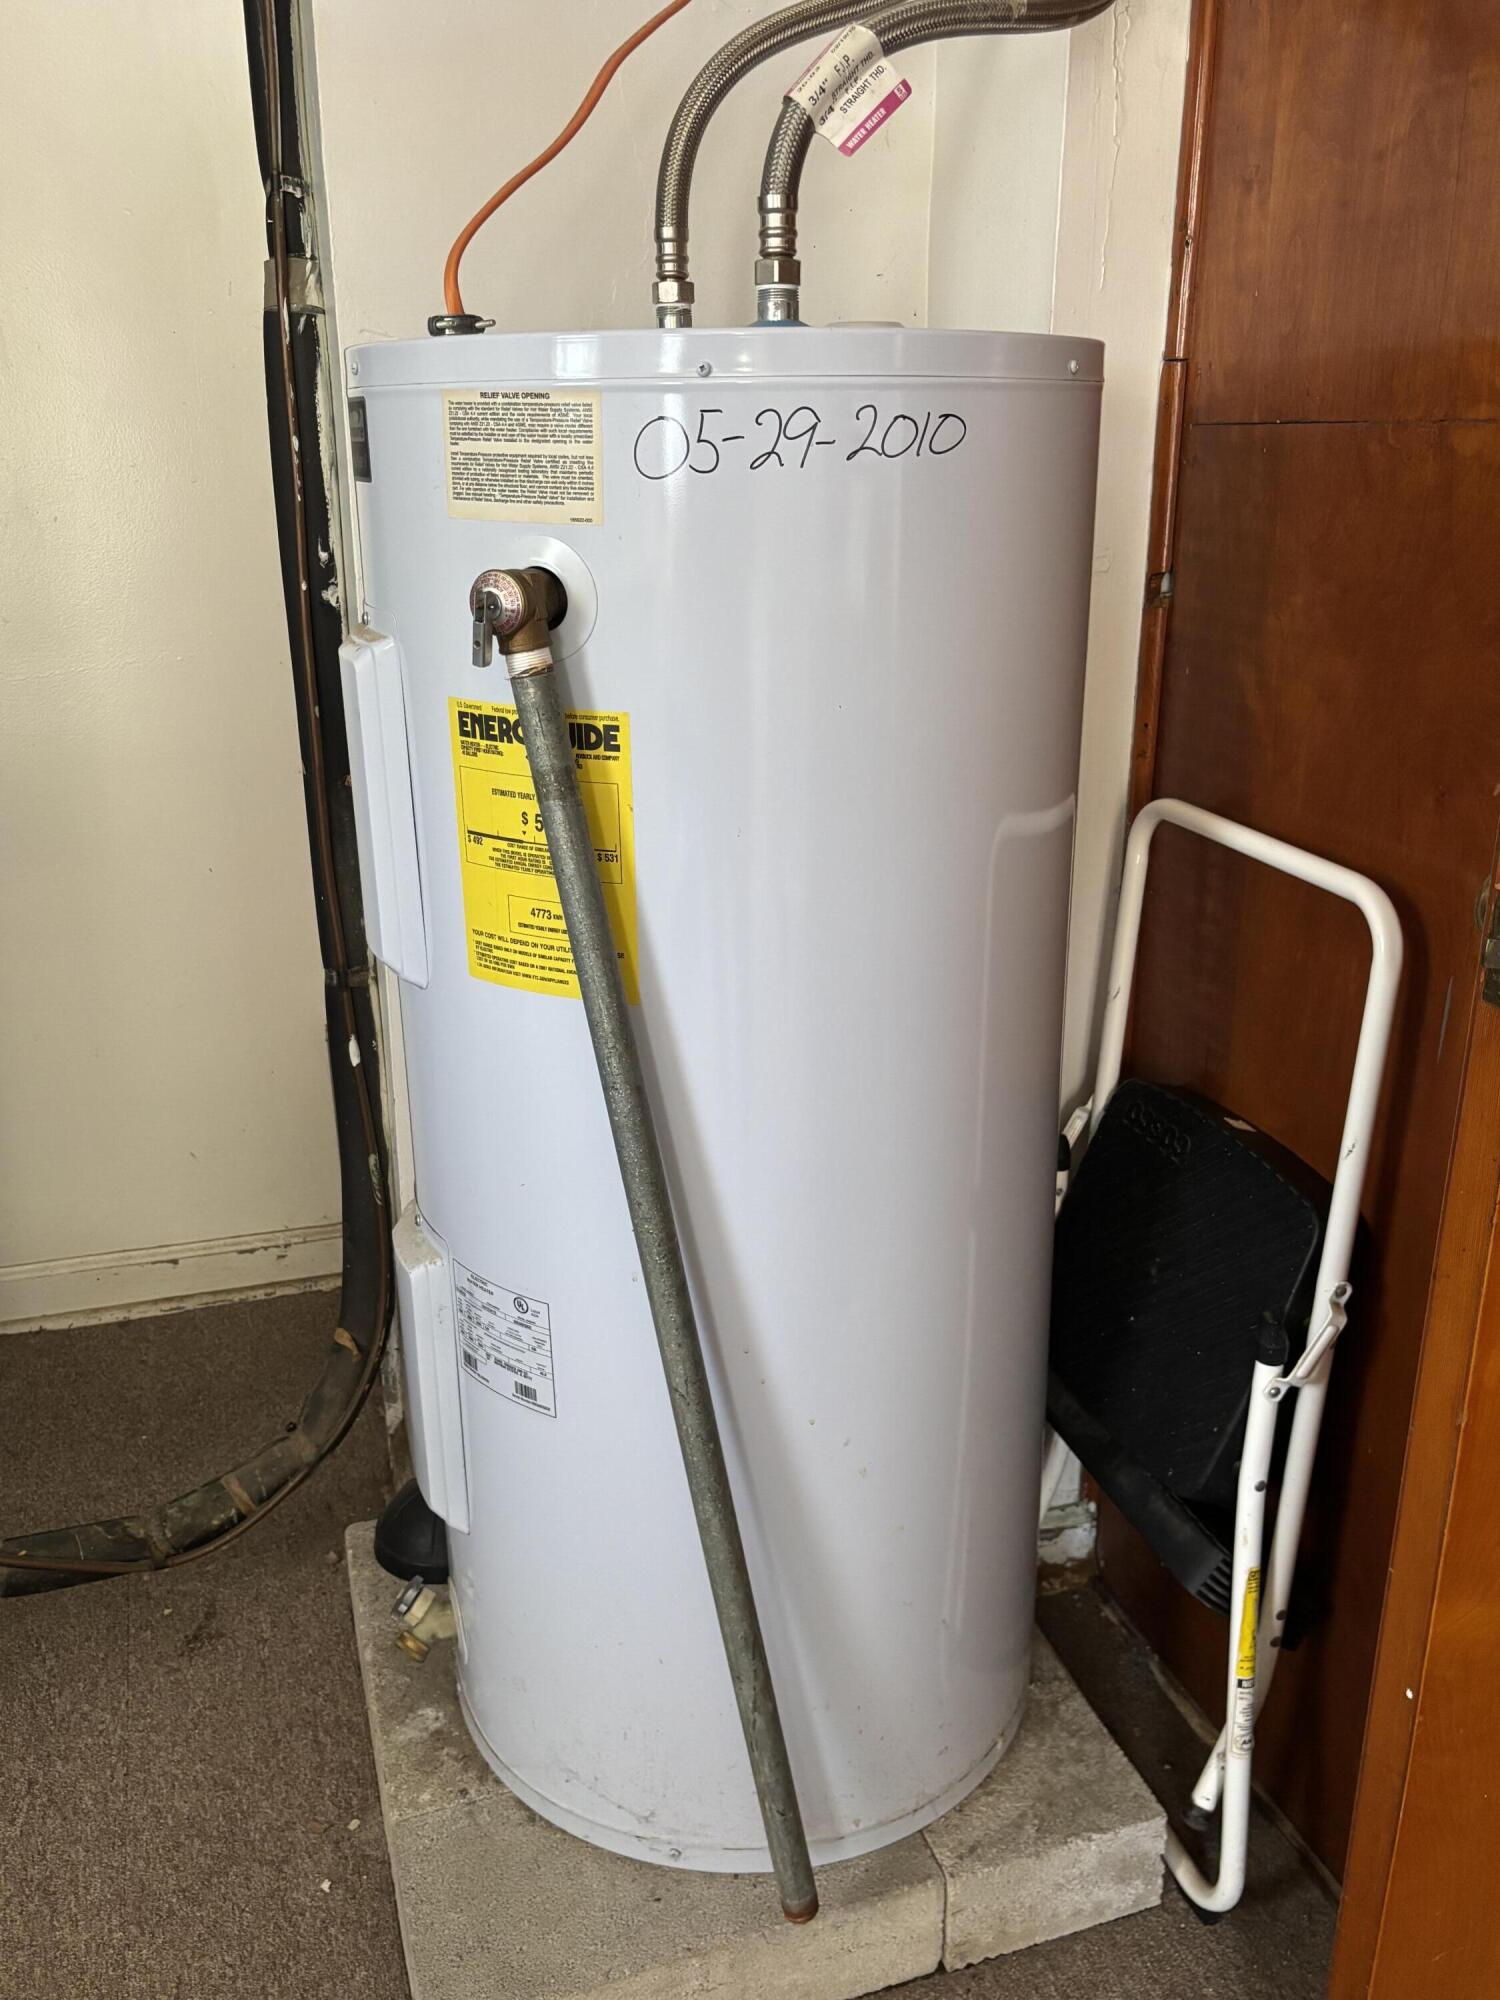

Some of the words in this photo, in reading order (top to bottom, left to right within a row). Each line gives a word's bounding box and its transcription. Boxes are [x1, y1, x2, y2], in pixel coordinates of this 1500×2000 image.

[840, 78, 872, 114] STRAIGHT
[846, 125, 868, 149] WATER
[864, 107, 887, 130] HEATER
[480, 391, 499, 399] RELIEF
[501, 391, 520, 399] VALVE
[521, 392, 550, 400] OPENING
[492, 788, 517, 798] ESTIMATED
[517, 792, 536, 801] YEARLY
[521, 811, 529, 827] $
[604, 854, 619, 863] 531
[530, 907, 552, 920] 4773
[472, 928, 485, 937] YOUR
[497, 935, 509, 943] WILL
[510, 938, 530, 947] DEPEND
[531, 941, 539, 949] ON
[540, 944, 555, 952] YOUR
